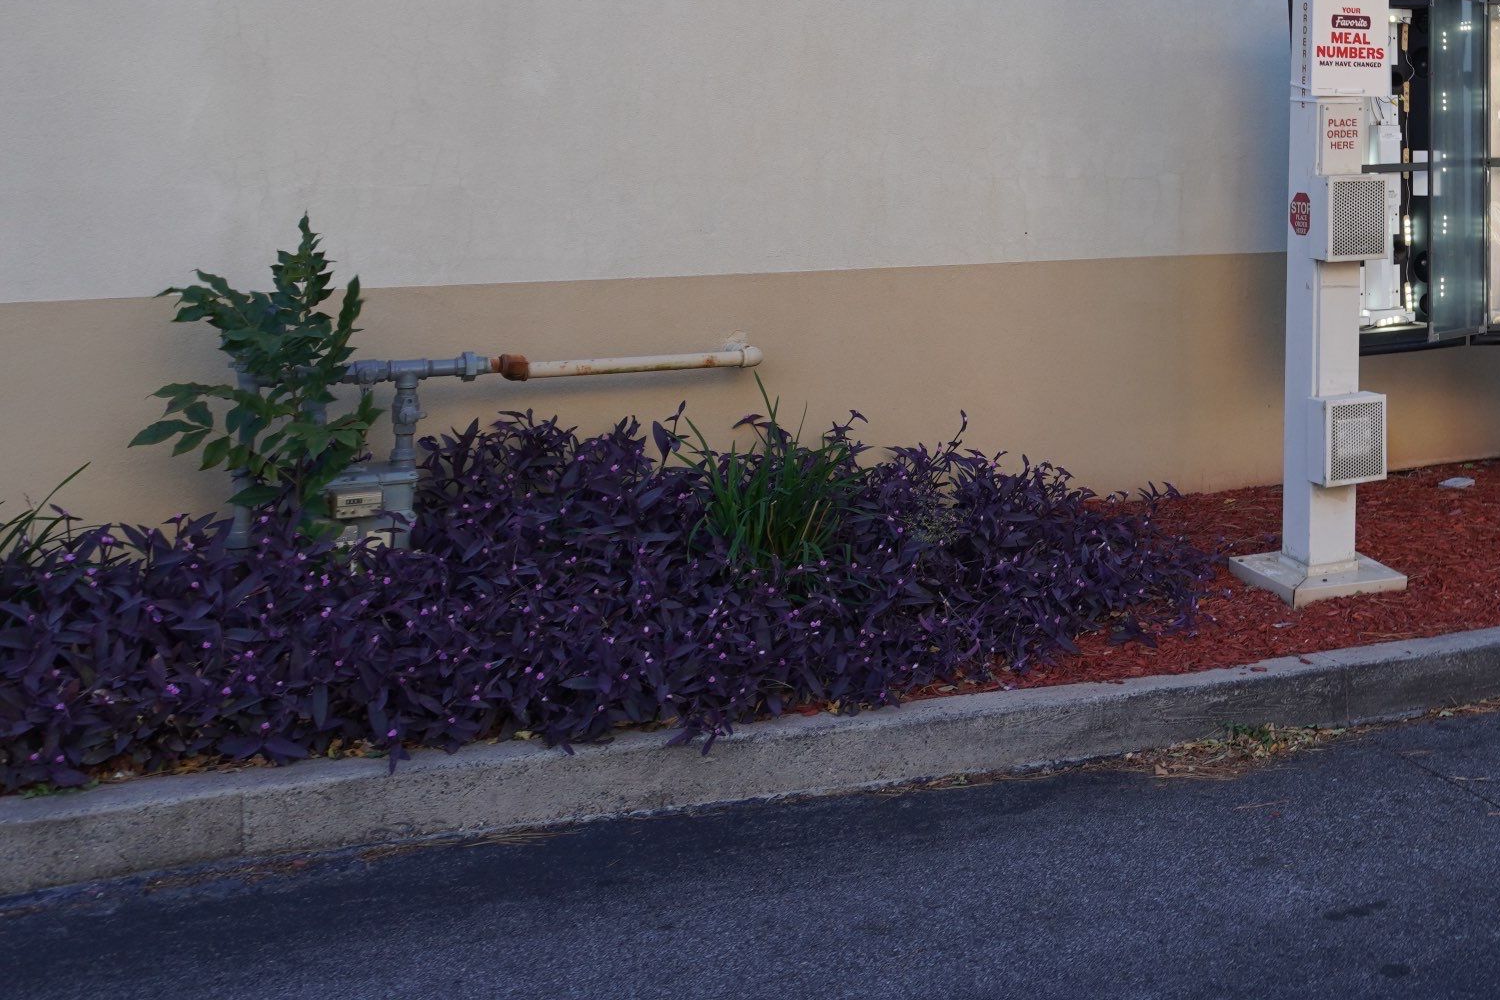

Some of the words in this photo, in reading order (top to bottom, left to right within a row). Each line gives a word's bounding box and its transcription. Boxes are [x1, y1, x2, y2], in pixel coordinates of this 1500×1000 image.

[1335, 16, 1368, 27] Favorite
[1331, 32, 1370, 45] MEAL
[1316, 45, 1384, 60] NUMBERS
[1328, 118, 1357, 127] PLACE
[1327, 129, 1358, 139] ORDER
[1330, 140, 1355, 149] HERE
